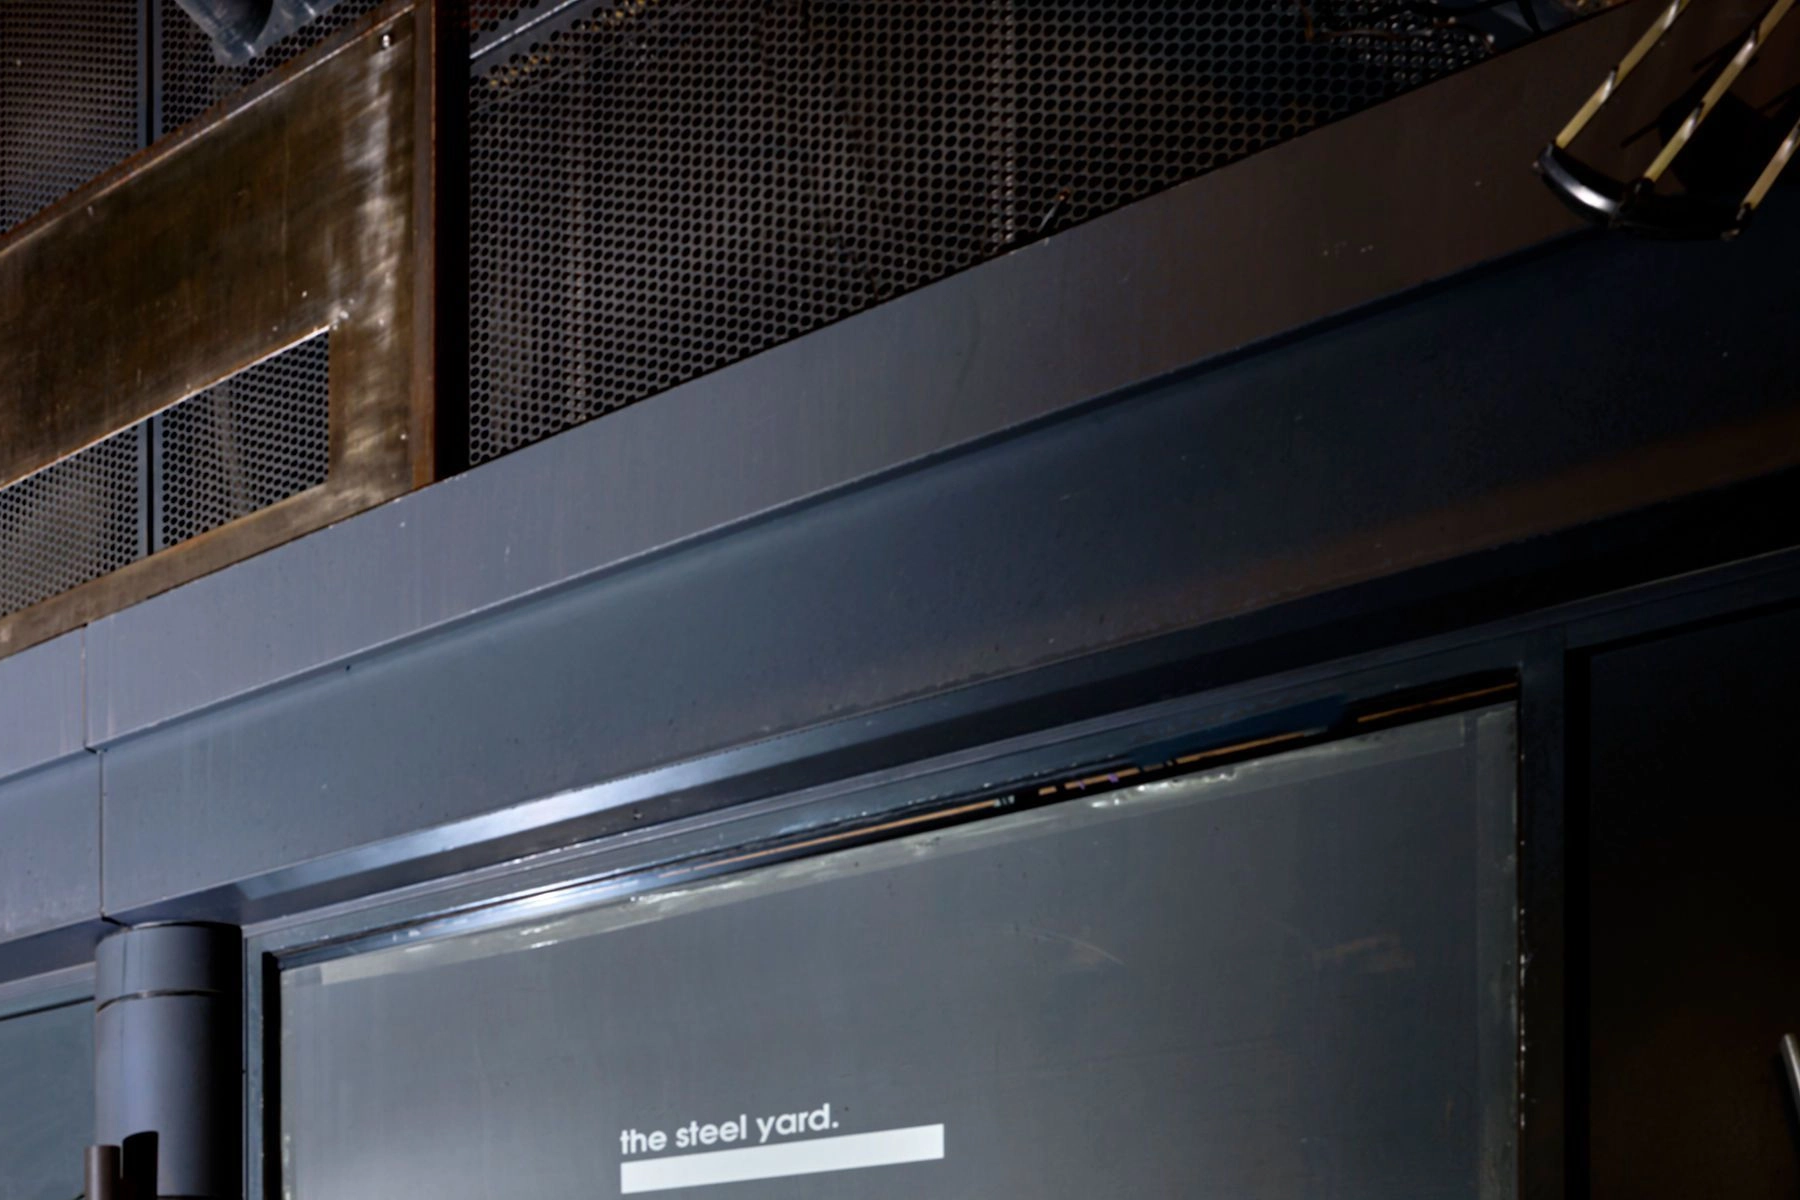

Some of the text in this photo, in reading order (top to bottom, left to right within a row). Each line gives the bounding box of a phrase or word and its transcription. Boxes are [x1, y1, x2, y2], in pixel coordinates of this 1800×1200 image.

[620, 1102, 840, 1155] the steel yard.
